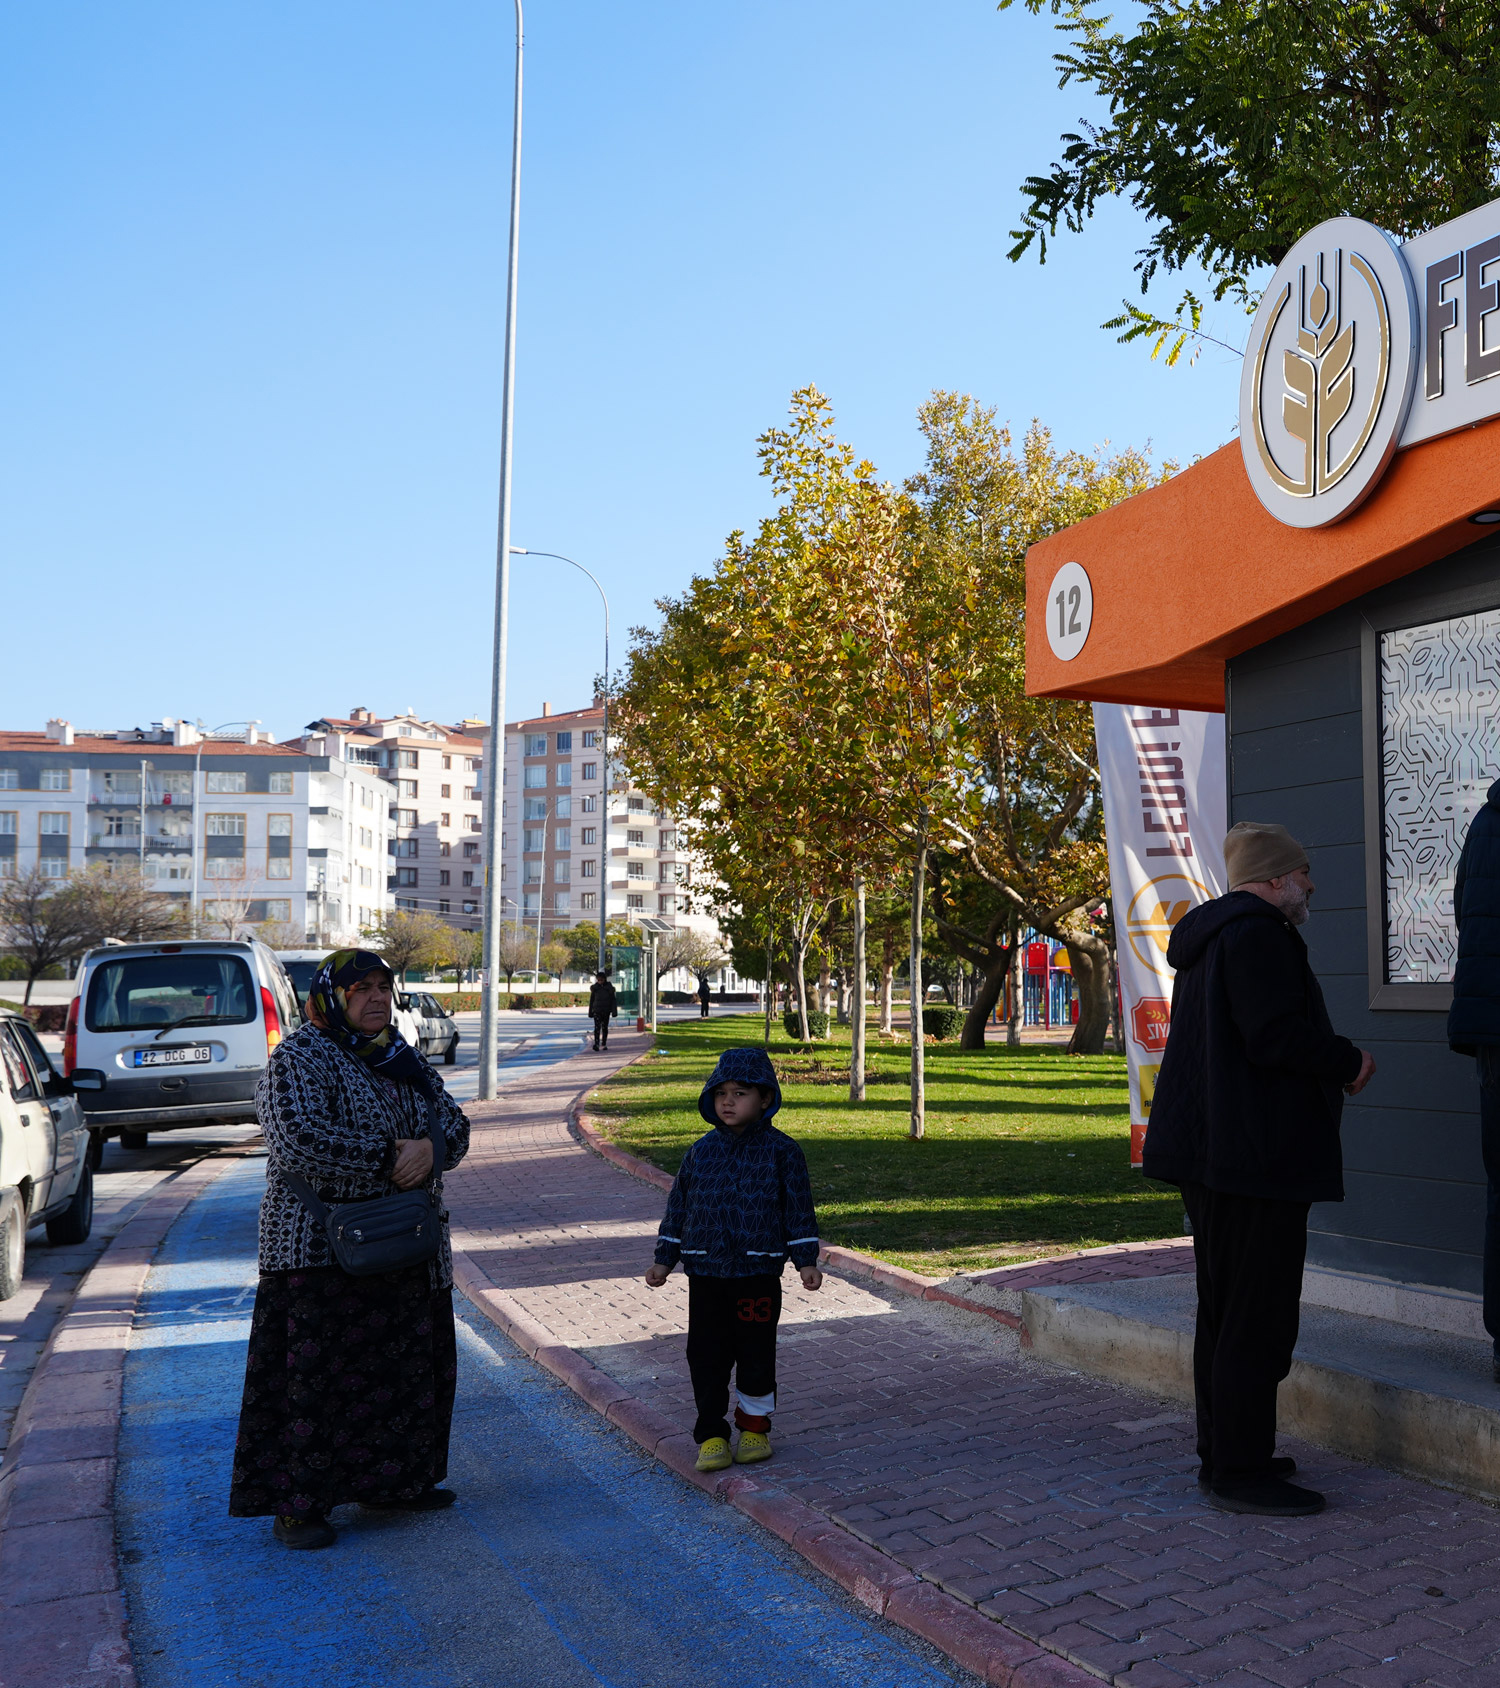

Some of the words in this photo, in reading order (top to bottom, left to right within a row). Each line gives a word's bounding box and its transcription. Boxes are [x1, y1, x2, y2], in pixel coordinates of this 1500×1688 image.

[1056, 585, 1081, 637] 12
[142, 1052, 156, 1063] 42
[165, 1050, 185, 1061] DCG
[194, 1049, 208, 1060] 06
[737, 1297, 772, 1322] 33
